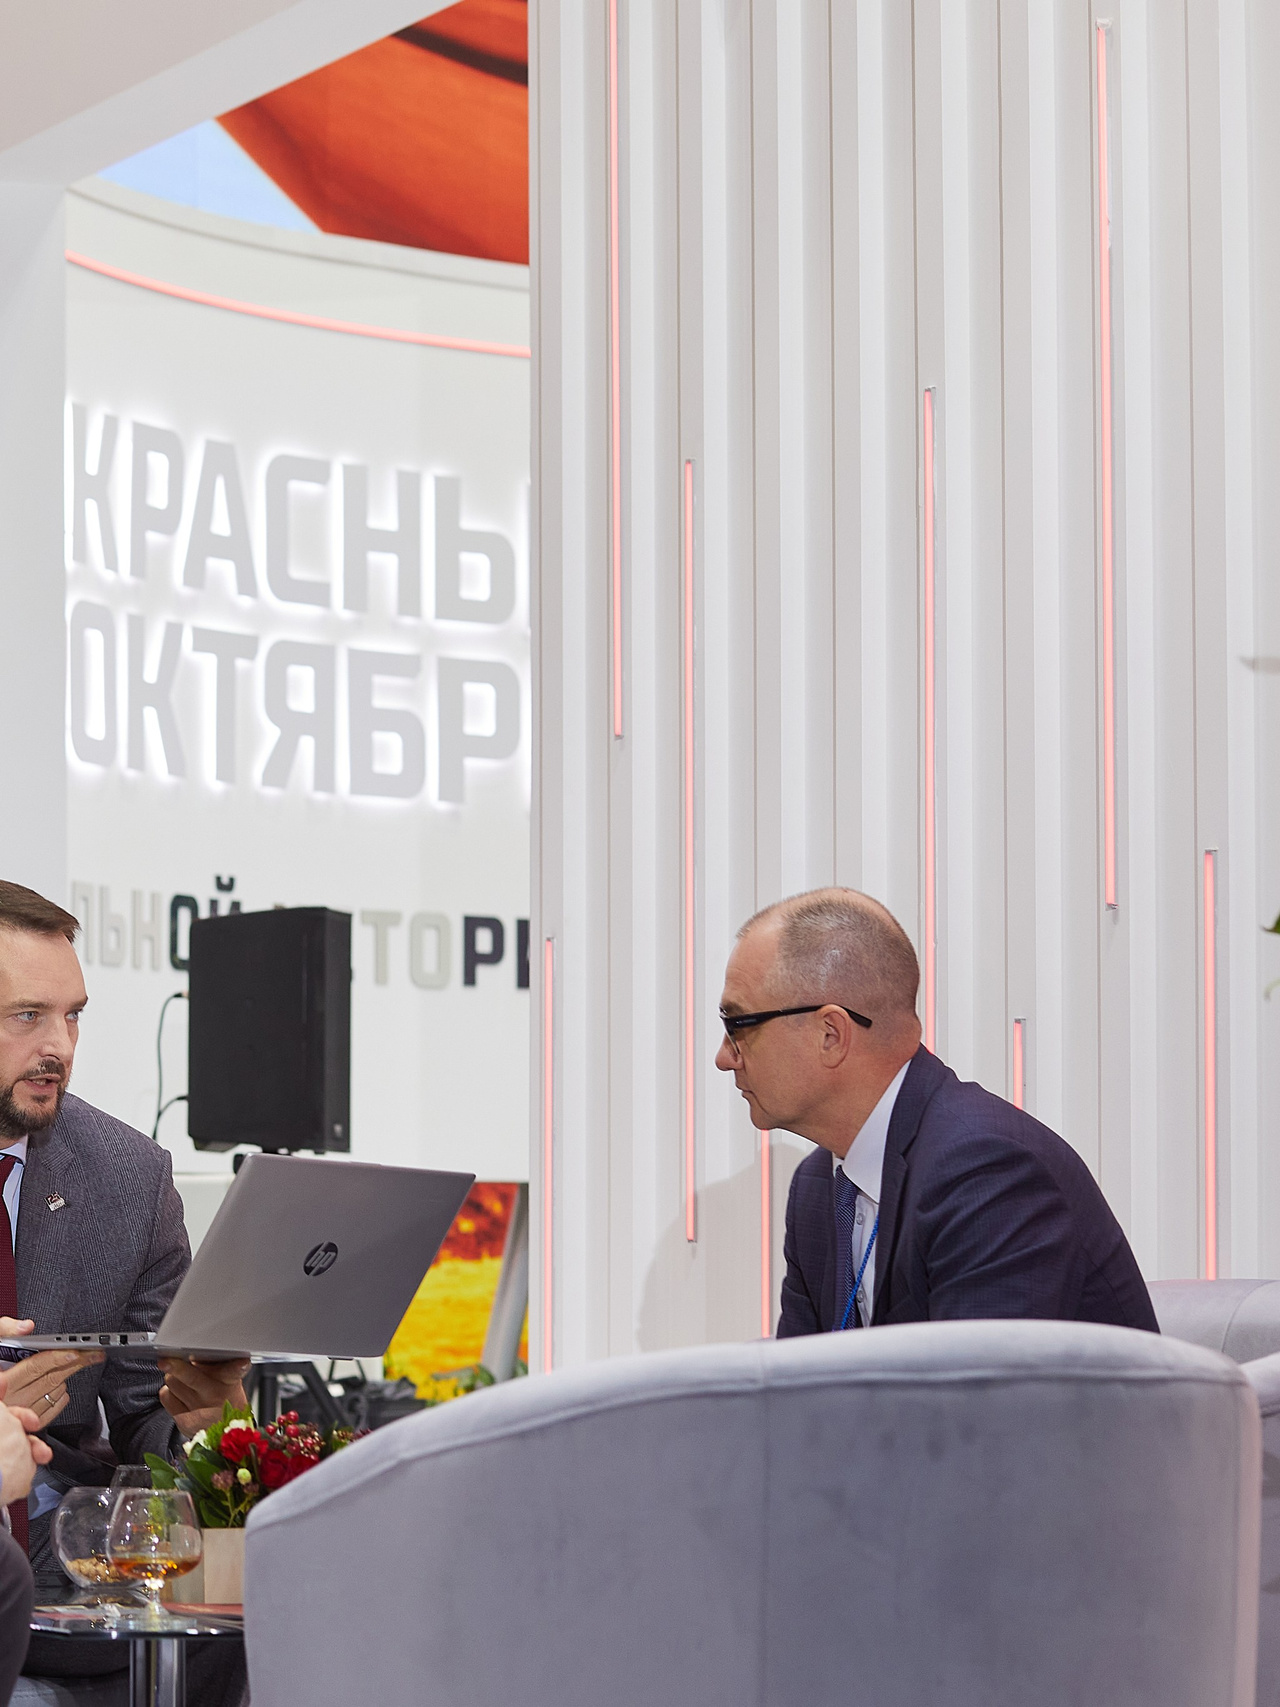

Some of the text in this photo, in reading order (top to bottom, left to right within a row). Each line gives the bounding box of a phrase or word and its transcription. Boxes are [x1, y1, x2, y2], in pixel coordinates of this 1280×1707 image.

[70, 600, 529, 804] ОКТЯБР
[360, 910, 530, 989] ТОР
[304, 1241, 338, 1277] hp
